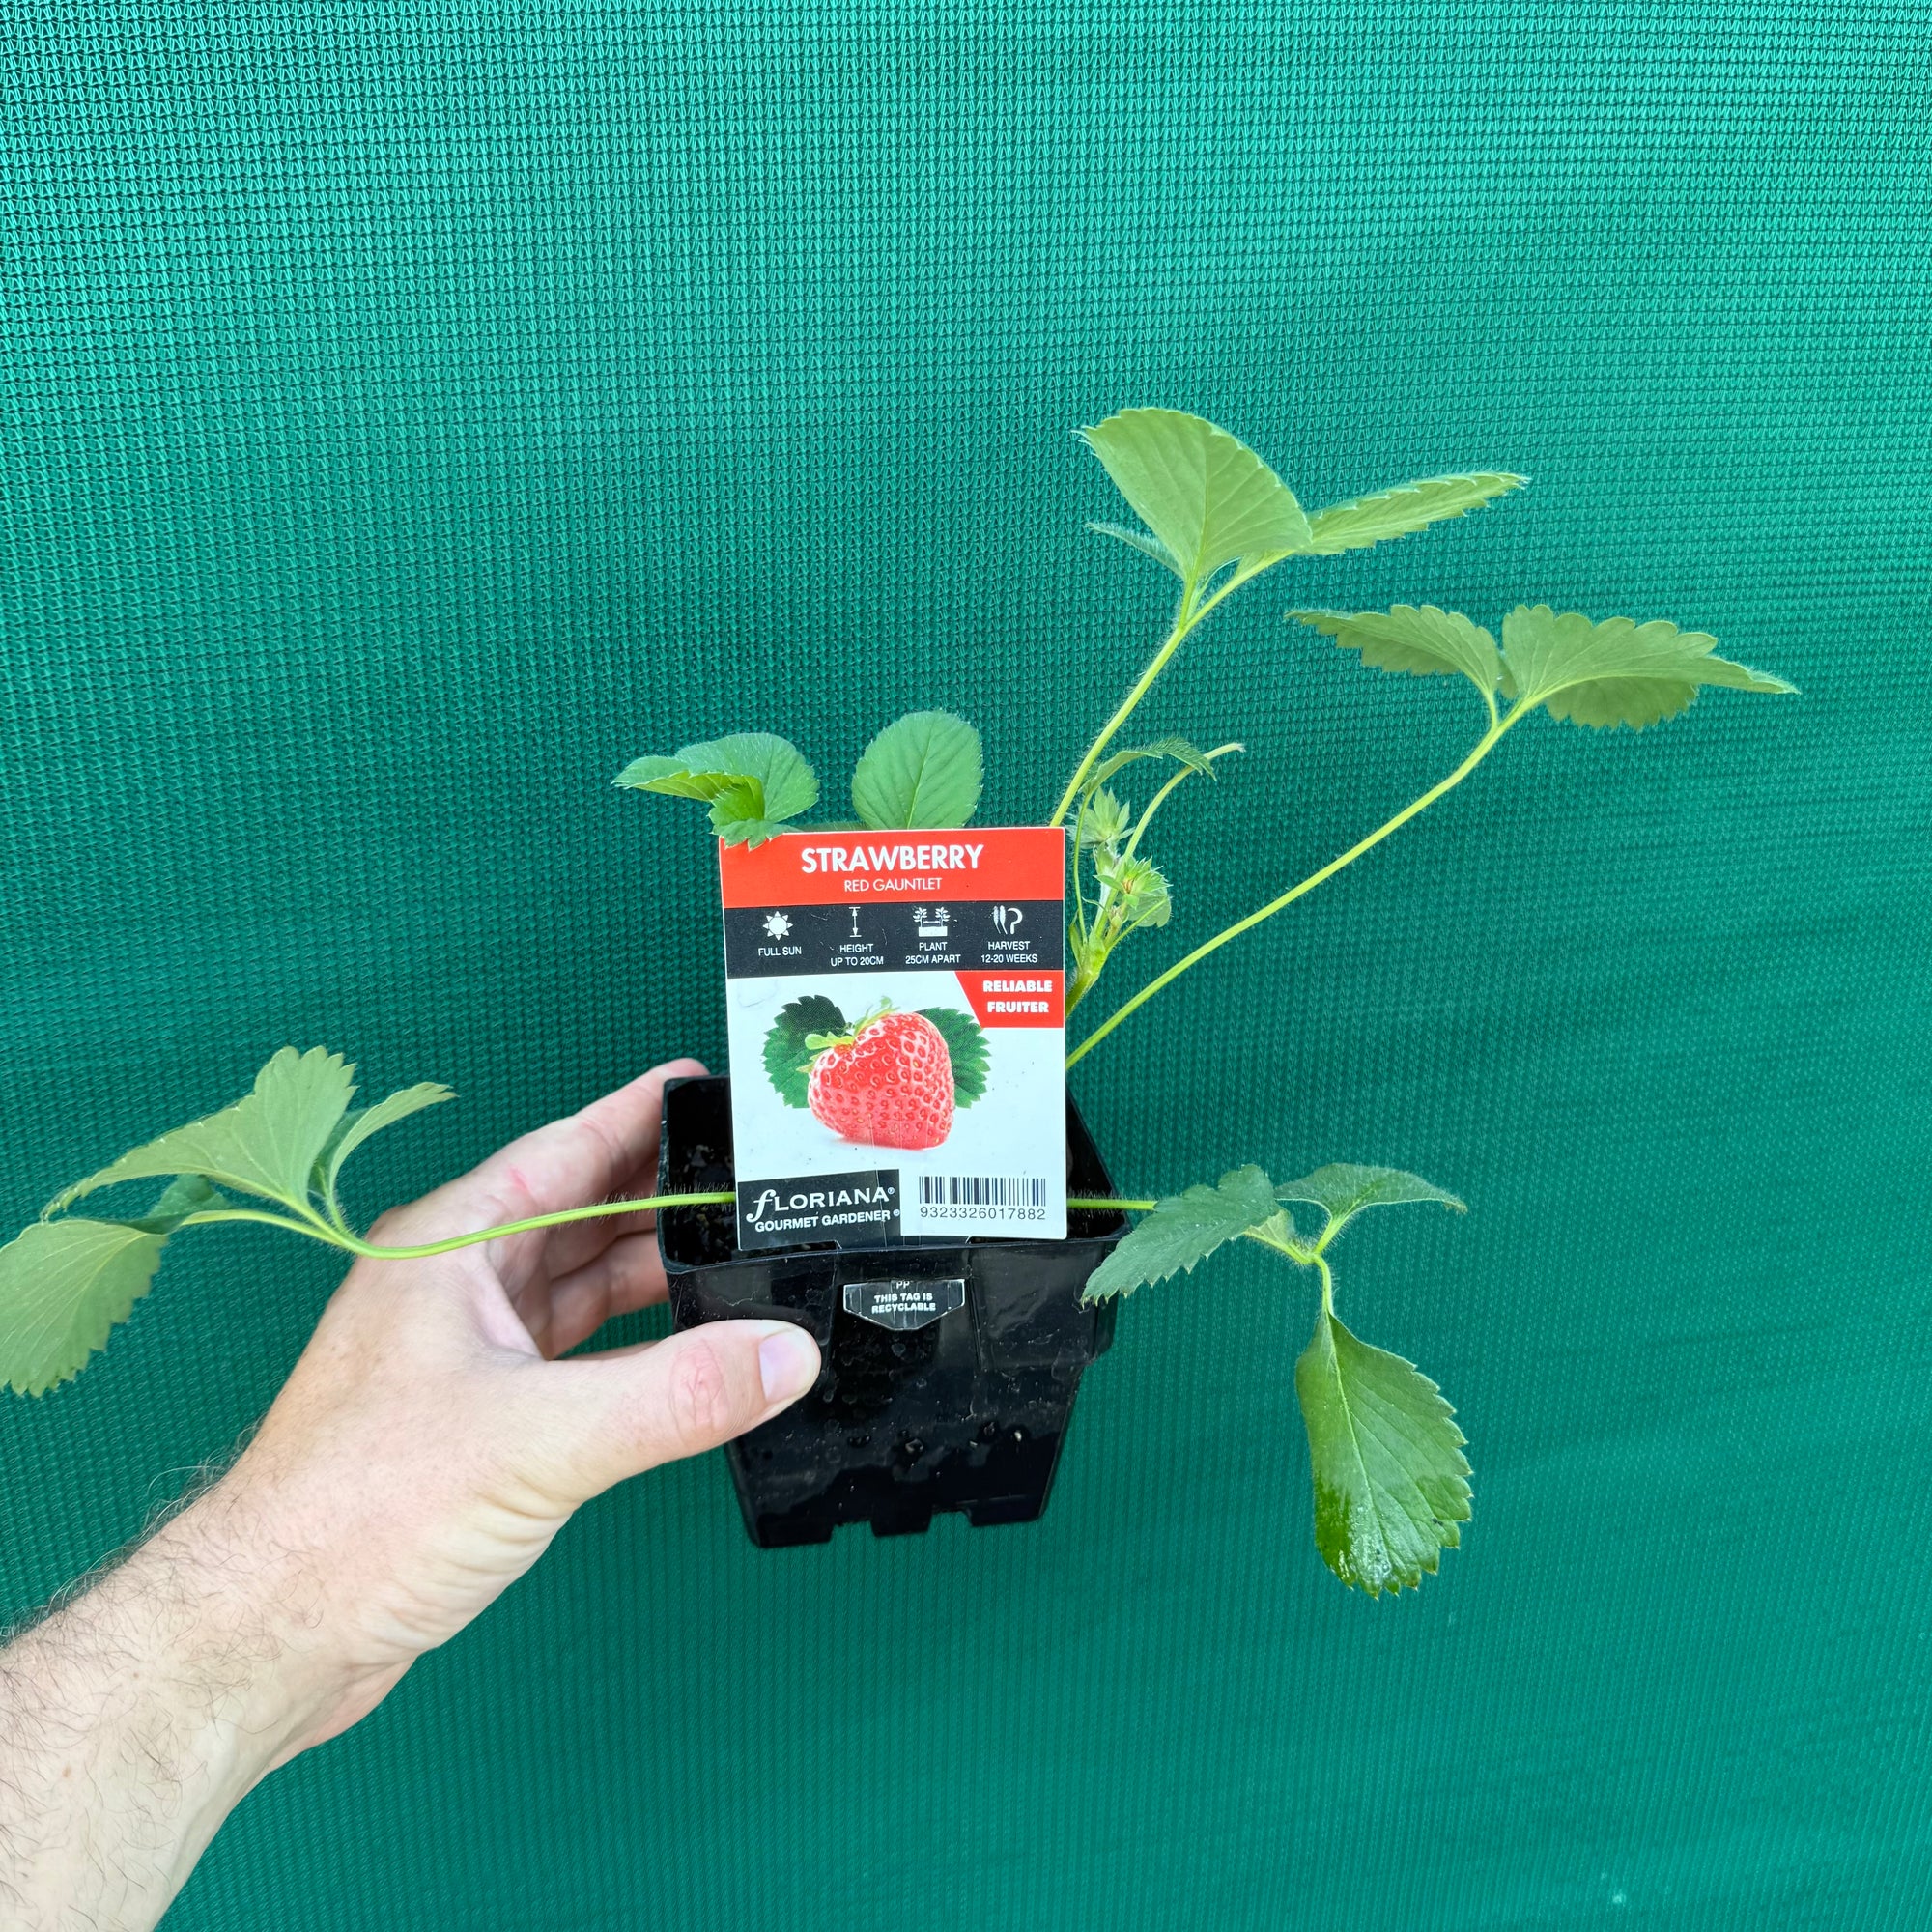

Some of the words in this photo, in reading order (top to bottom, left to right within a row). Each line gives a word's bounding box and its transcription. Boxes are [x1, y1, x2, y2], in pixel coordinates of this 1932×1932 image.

[801, 844, 984, 874] STRAWBERRY
[844, 879, 870, 892] RED
[873, 877, 942, 891] GAUNTLET
[840, 944, 873, 953] HEIGHT
[919, 942, 947, 952] PLANT
[988, 941, 1030, 951] HARVEST
[758, 947, 780, 957] FULL
[782, 947, 801, 956] SUN
[831, 957, 842, 966] UP
[845, 956, 858, 966] TO
[860, 955, 884, 965] 20CM
[905, 955, 929, 965] 25CM
[931, 954, 961, 964] APART
[981, 954, 1004, 963] 12-20
[1006, 953, 1037, 963] WEEKS
[983, 980, 1052, 993] RELIABLE
[987, 1001, 1049, 1013] FRUITER
[920, 1207, 1046, 1220] 9323326017882
[755, 1216, 818, 1233] GOURMET
[874, 1293, 897, 1303] THIS
[900, 1293, 920, 1302] TAG
[923, 1293, 933, 1301] IS
[871, 1303, 936, 1314] RECYCLABLE
